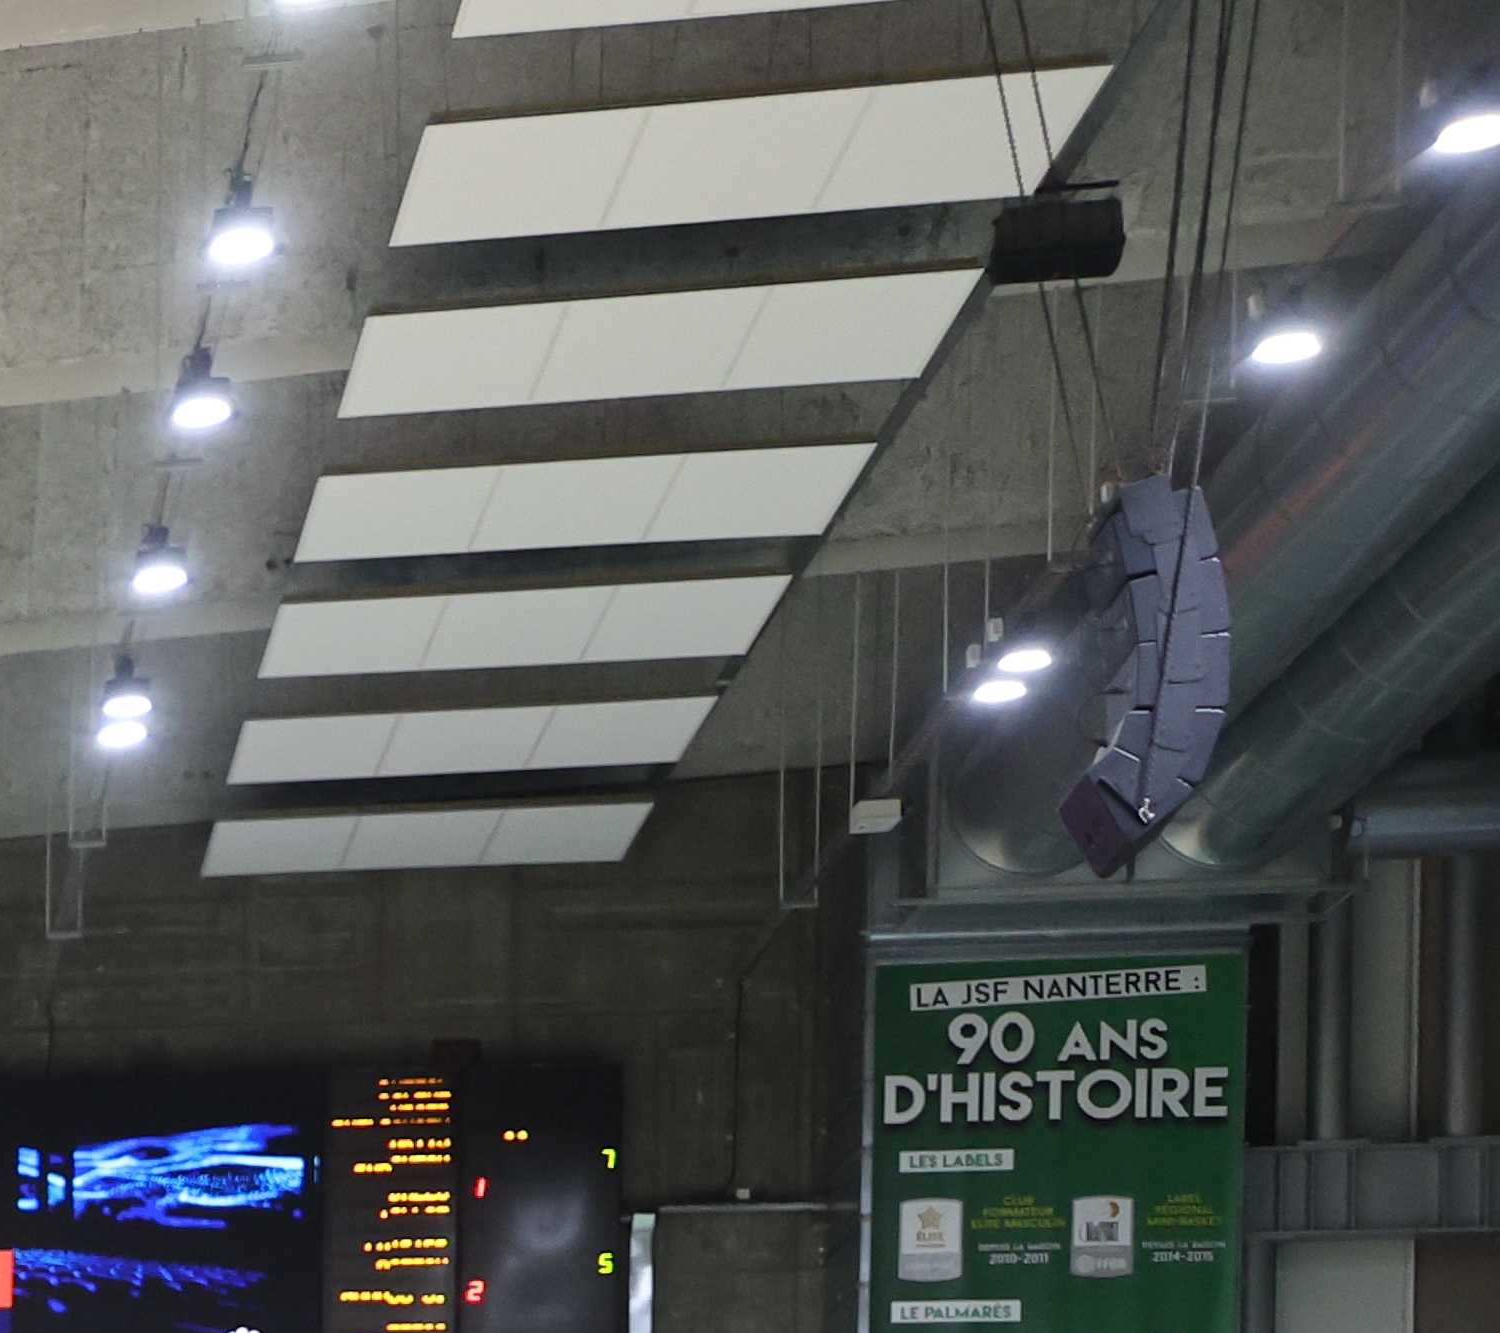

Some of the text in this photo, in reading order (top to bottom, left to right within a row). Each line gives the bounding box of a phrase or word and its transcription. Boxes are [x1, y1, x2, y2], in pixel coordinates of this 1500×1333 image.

[916, 969, 1182, 1008] LA JSF NANTERRE
[948, 1011, 1169, 1066] 90 ANS
[884, 1066, 1230, 1125] D'HISTOIRE
[602, 1148, 616, 1169] 7
[909, 1153, 1003, 1169] LES LABELS
[475, 1177, 488, 1198] 1
[597, 1252, 615, 1275] 5
[465, 1280, 486, 1303] 2
[901, 1306, 919, 1321] LE
